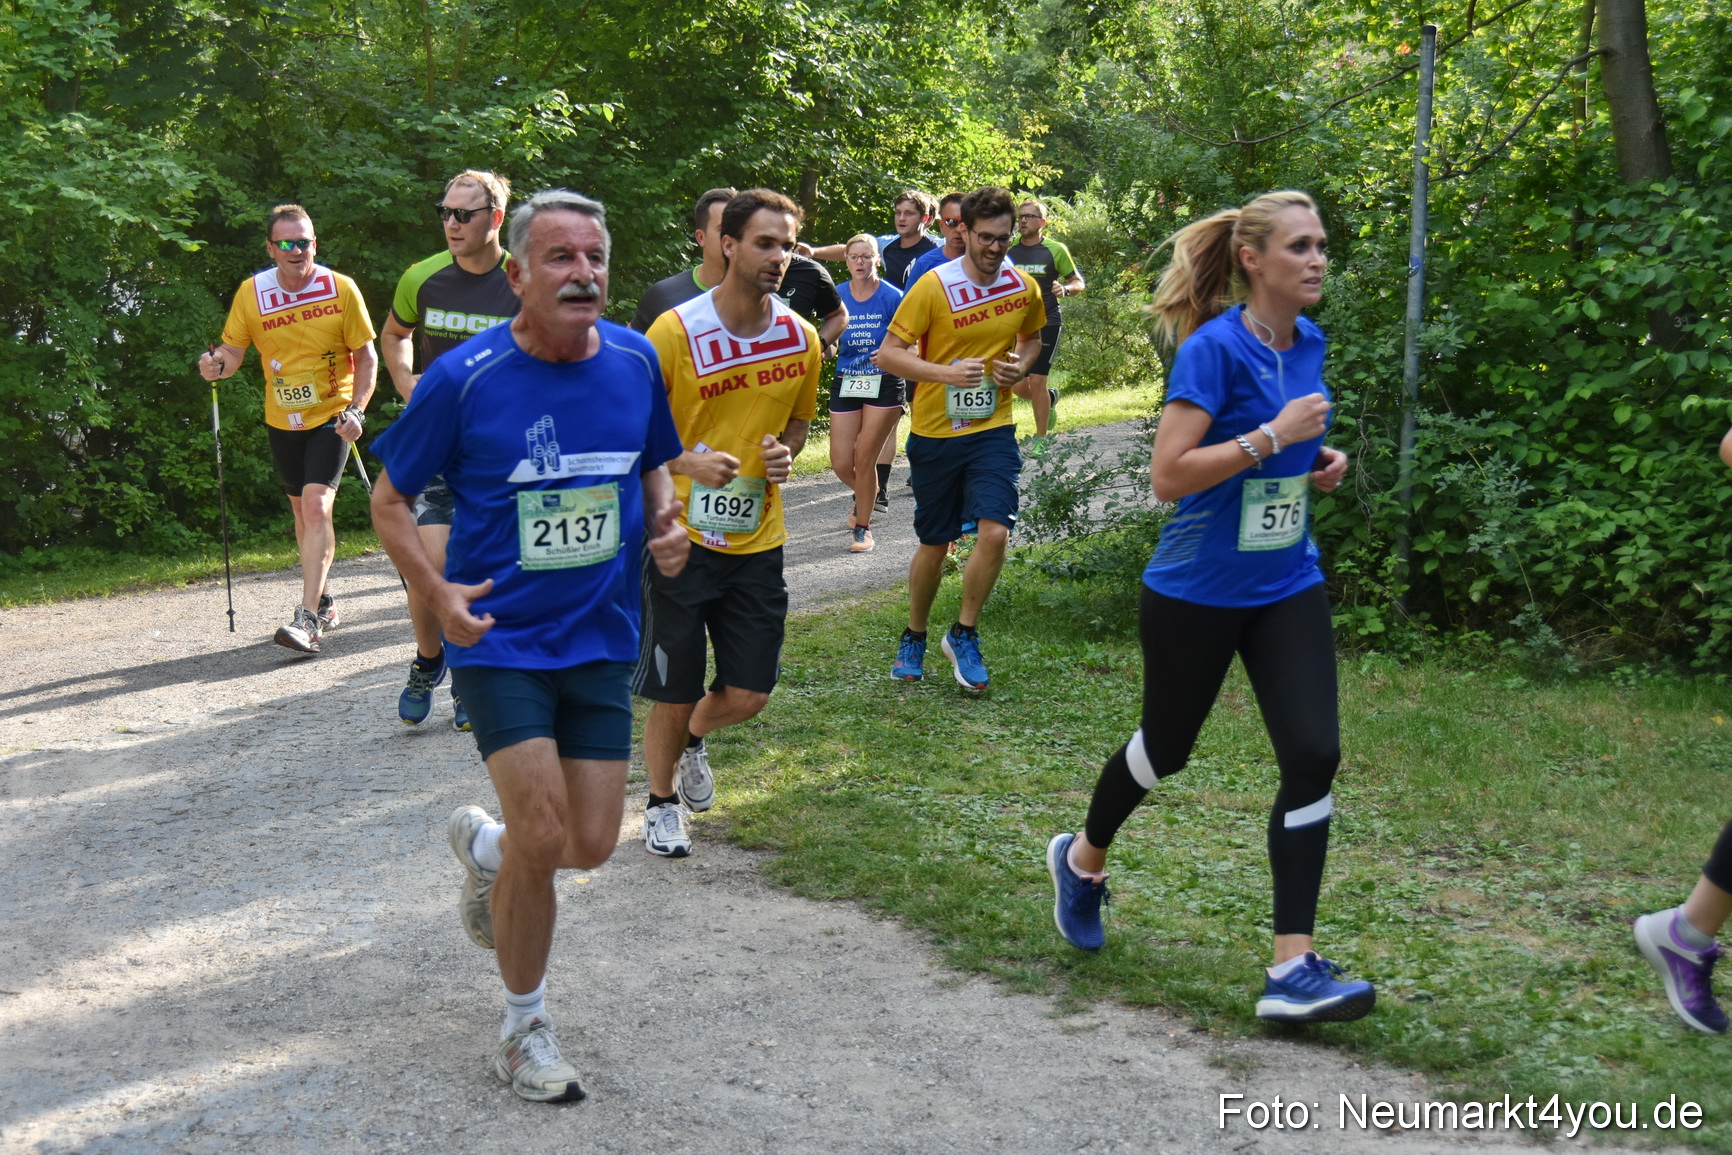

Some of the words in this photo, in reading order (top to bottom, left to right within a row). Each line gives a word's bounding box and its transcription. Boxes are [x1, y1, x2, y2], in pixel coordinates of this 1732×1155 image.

[1014, 264, 1048, 274] OCK
[262, 314, 298, 331] MAX
[301, 304, 343, 321] BÖGL
[953, 309, 991, 330] MAX
[994, 297, 1031, 317] BÖGL
[846, 322, 881, 330] ausverkauf
[449, 332, 458, 340] by
[848, 339, 876, 347] LAUFEN
[474, 349, 493, 362] JAKO
[699, 373, 750, 401] MAX
[757, 361, 807, 386] BÖGL
[849, 380, 871, 390] 733
[277, 385, 312, 401] 1588
[953, 391, 992, 407] 1653
[701, 493, 754, 518] 1692
[727, 517, 745, 525] Philipp
[1262, 501, 1300, 530] 576
[533, 513, 607, 547] 2137
